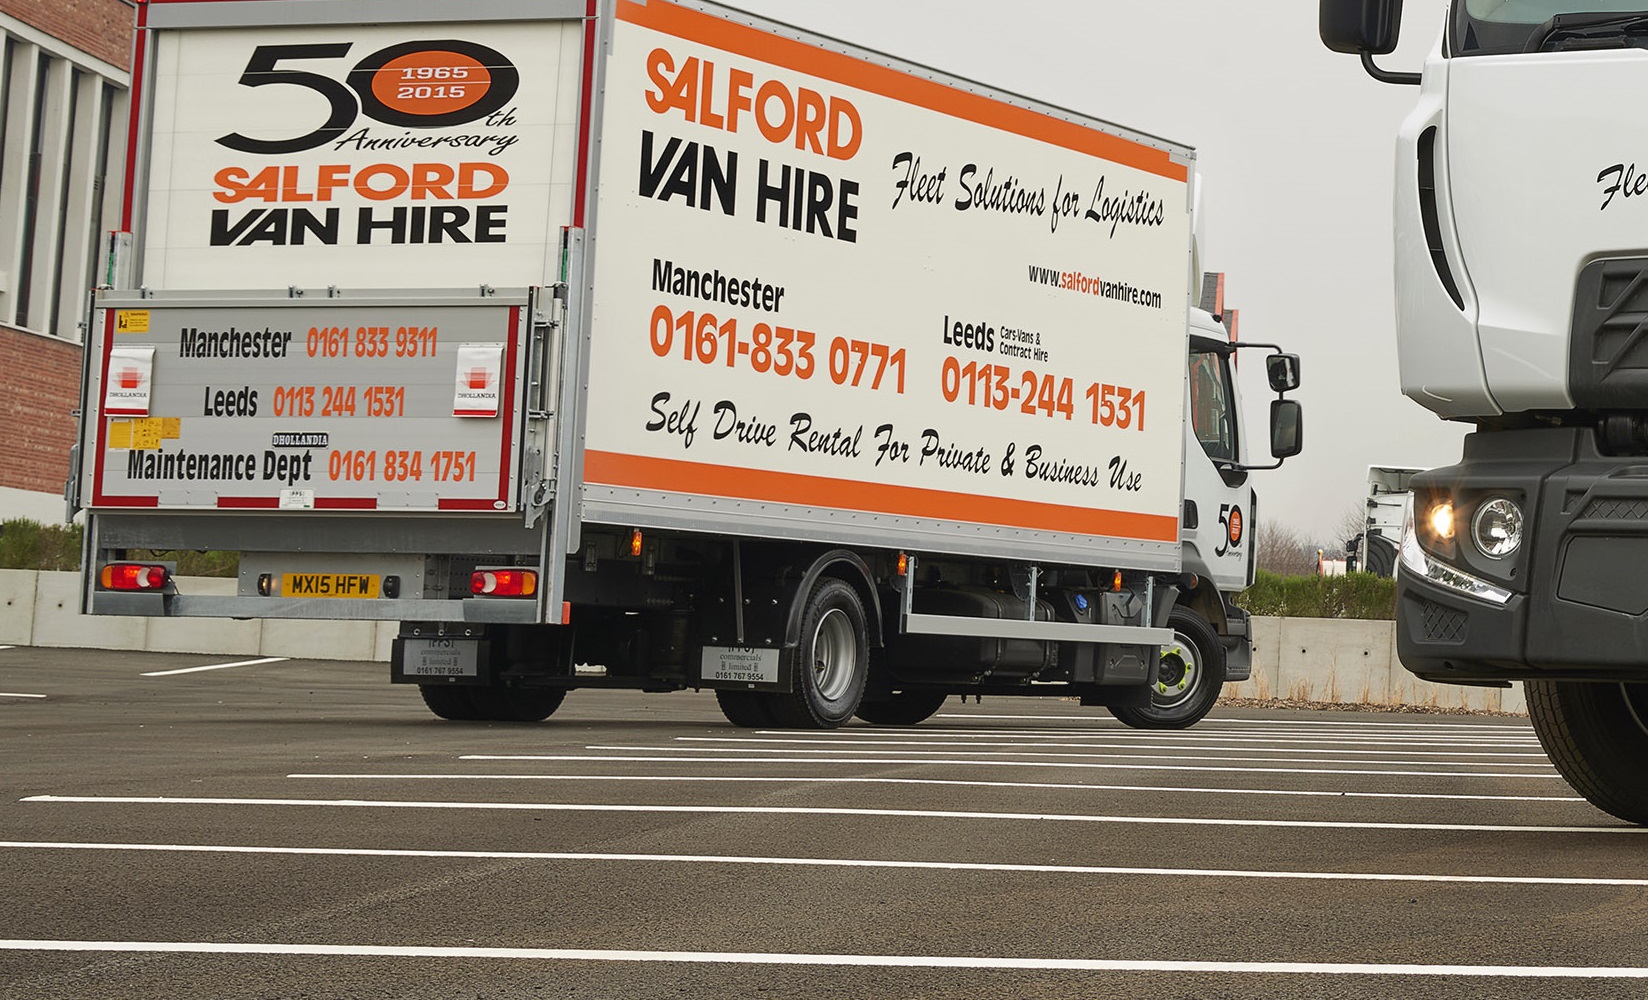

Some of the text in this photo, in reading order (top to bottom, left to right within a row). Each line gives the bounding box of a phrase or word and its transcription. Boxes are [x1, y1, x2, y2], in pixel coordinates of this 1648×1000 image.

[397, 86, 465, 99] 2015
[401, 67, 469, 80] 1965
[645, 47, 862, 161] SALFORD
[335, 126, 519, 156] Anniversary
[213, 162, 509, 203] SALFORD
[638, 129, 860, 244] VAN HIRE
[891, 152, 1164, 239] Fleet Solutions for Logistics
[209, 205, 508, 246] VAN HIRE
[652, 258, 785, 313] Manchester
[1028, 265, 1162, 309] www.salfordvanhire.com
[180, 327, 437, 359] Manchester 0161 833 9311
[650, 305, 906, 394] 0161-833 0771
[943, 315, 995, 353] Leeds
[1000, 342, 1048, 362] Contract Hire
[1036, 333, 1040, 345] &
[204, 386, 405, 417] Leeds 0113 244 1531
[941, 356, 1146, 432] 0113-244 1531
[272, 434, 328, 445] DHOLLANDIA
[646, 392, 1142, 491] Self Drive Rental For Private & Business Use
[127, 447, 476, 486] Maintenance Dept 0161 834 1751
[292, 576, 370, 594] MX15 HFW
[729, 663, 752, 671] limited
